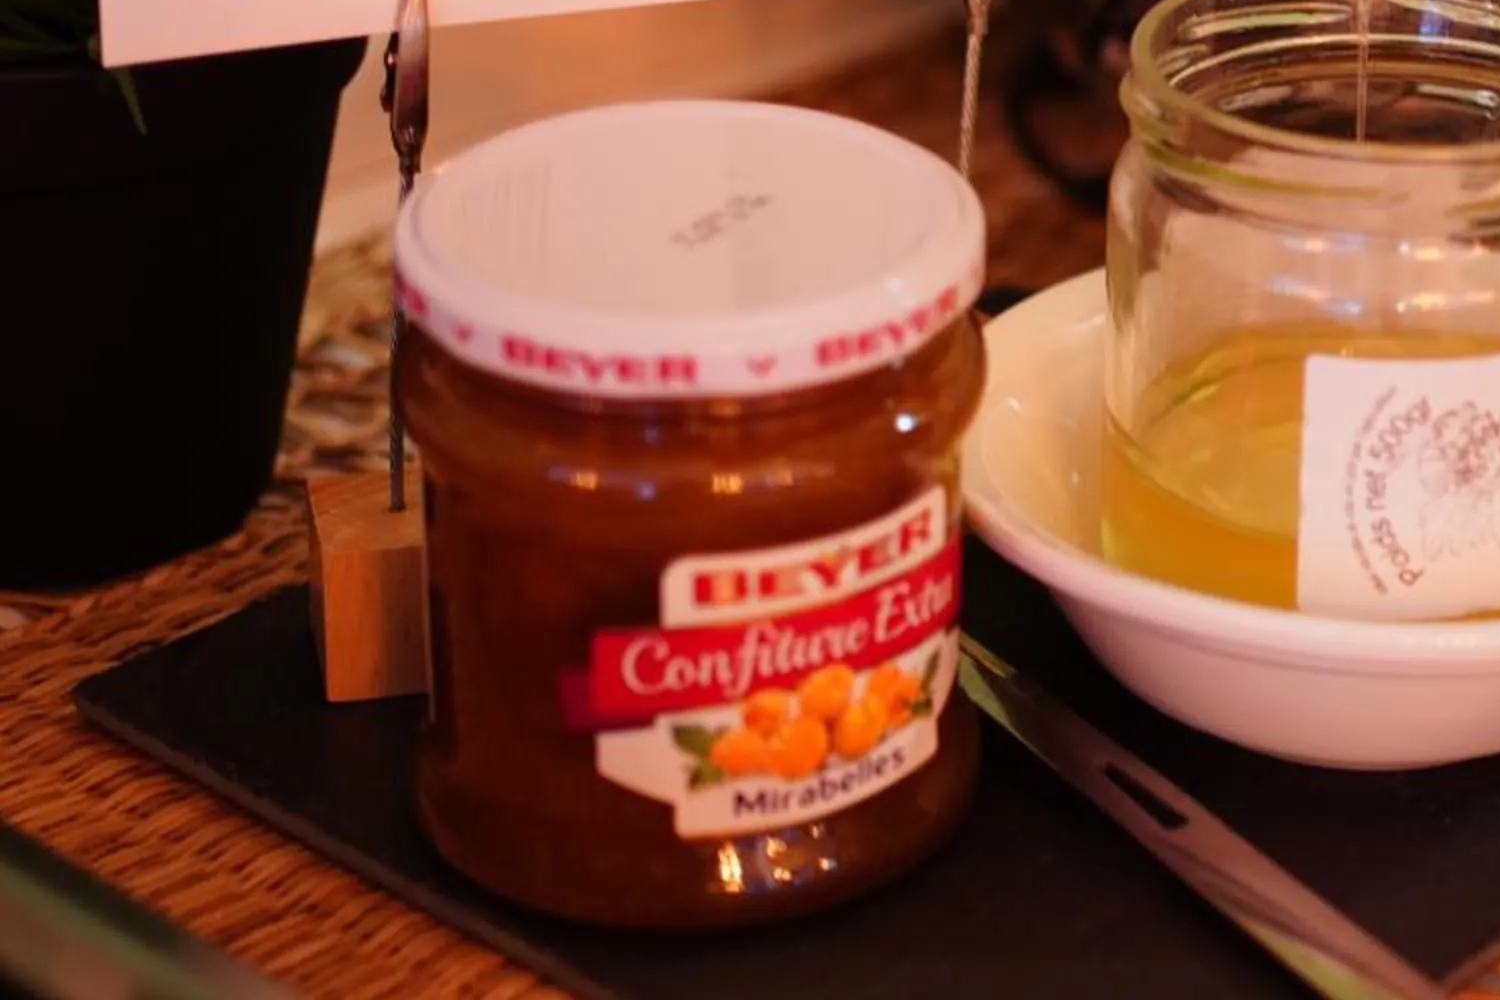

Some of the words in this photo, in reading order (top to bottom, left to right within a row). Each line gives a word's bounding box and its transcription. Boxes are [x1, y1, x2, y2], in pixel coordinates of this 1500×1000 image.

[502, 335, 698, 384] BEYER
[813, 284, 959, 367] BEYER
[692, 509, 932, 606] BEYER
[1370, 515, 1425, 587] Poids
[620, 617, 869, 700] Confiture
[732, 745, 906, 818] Mirabelles
